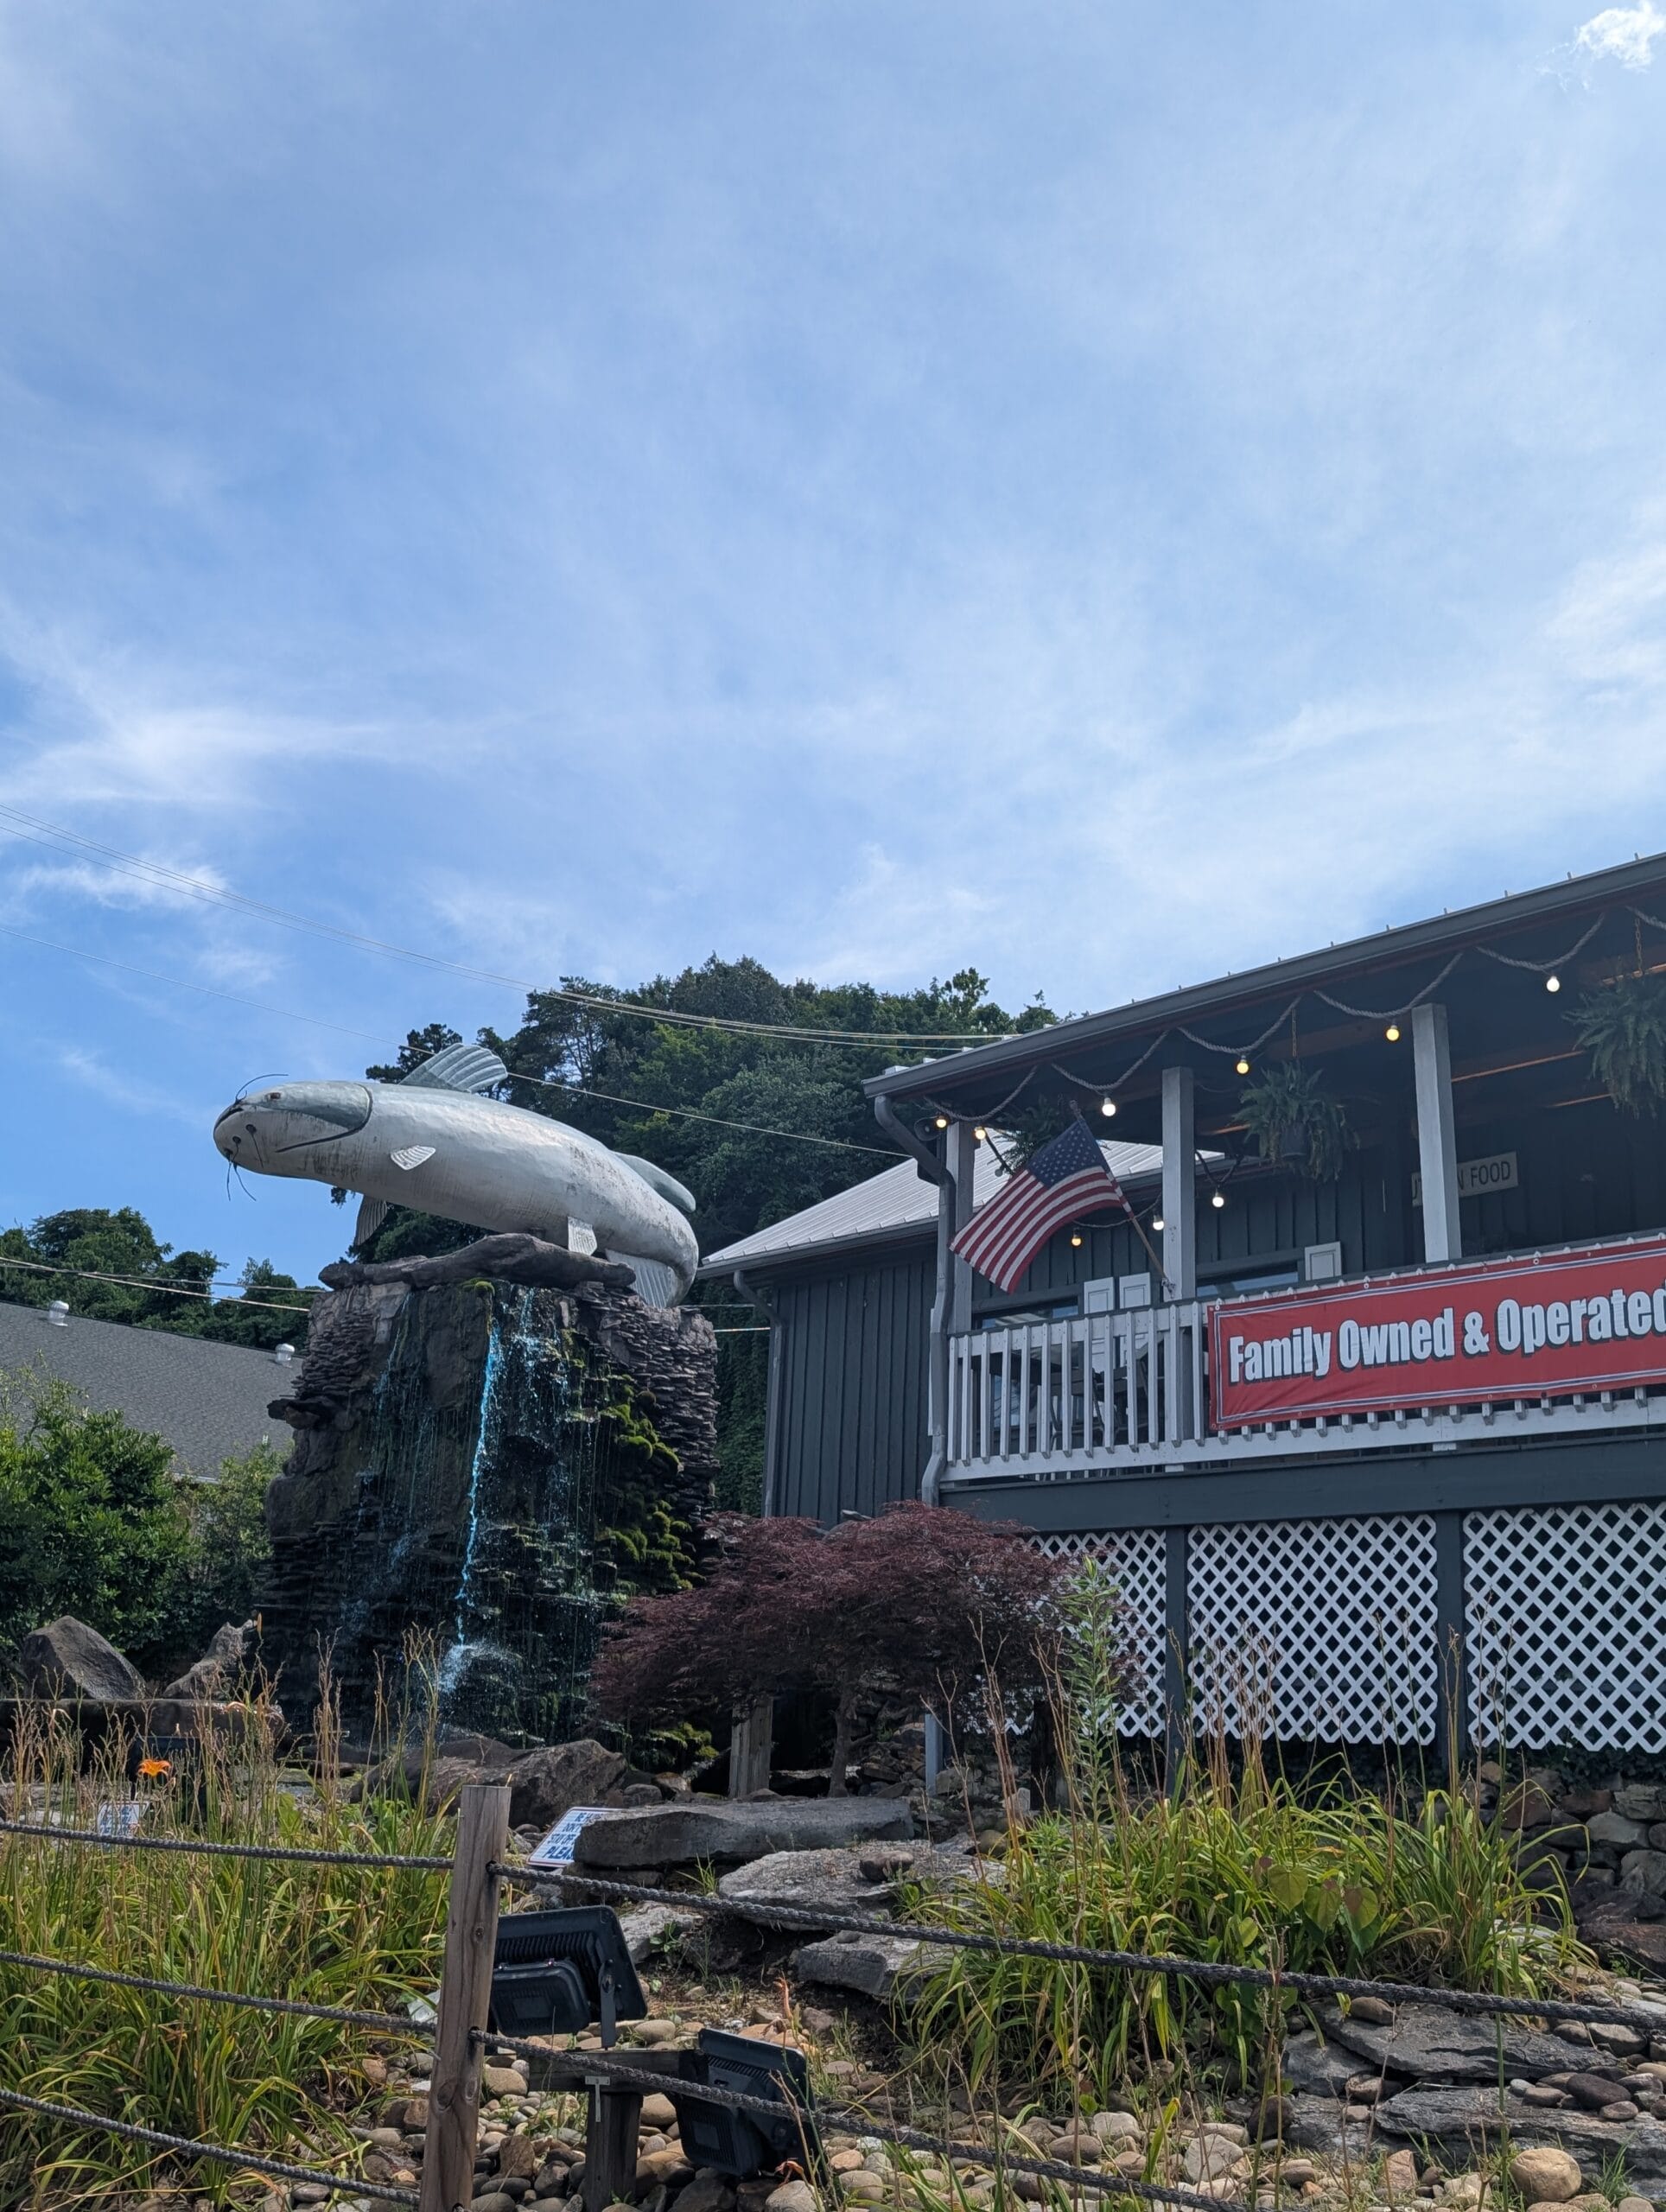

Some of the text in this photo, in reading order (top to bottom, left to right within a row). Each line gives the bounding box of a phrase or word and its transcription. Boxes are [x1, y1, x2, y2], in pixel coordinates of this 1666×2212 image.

[1471, 1160, 1510, 1188] FOOD
[1229, 1325, 1332, 1384] Family
[1339, 1306, 1455, 1368] Owned
[1463, 1311, 1490, 1355] &
